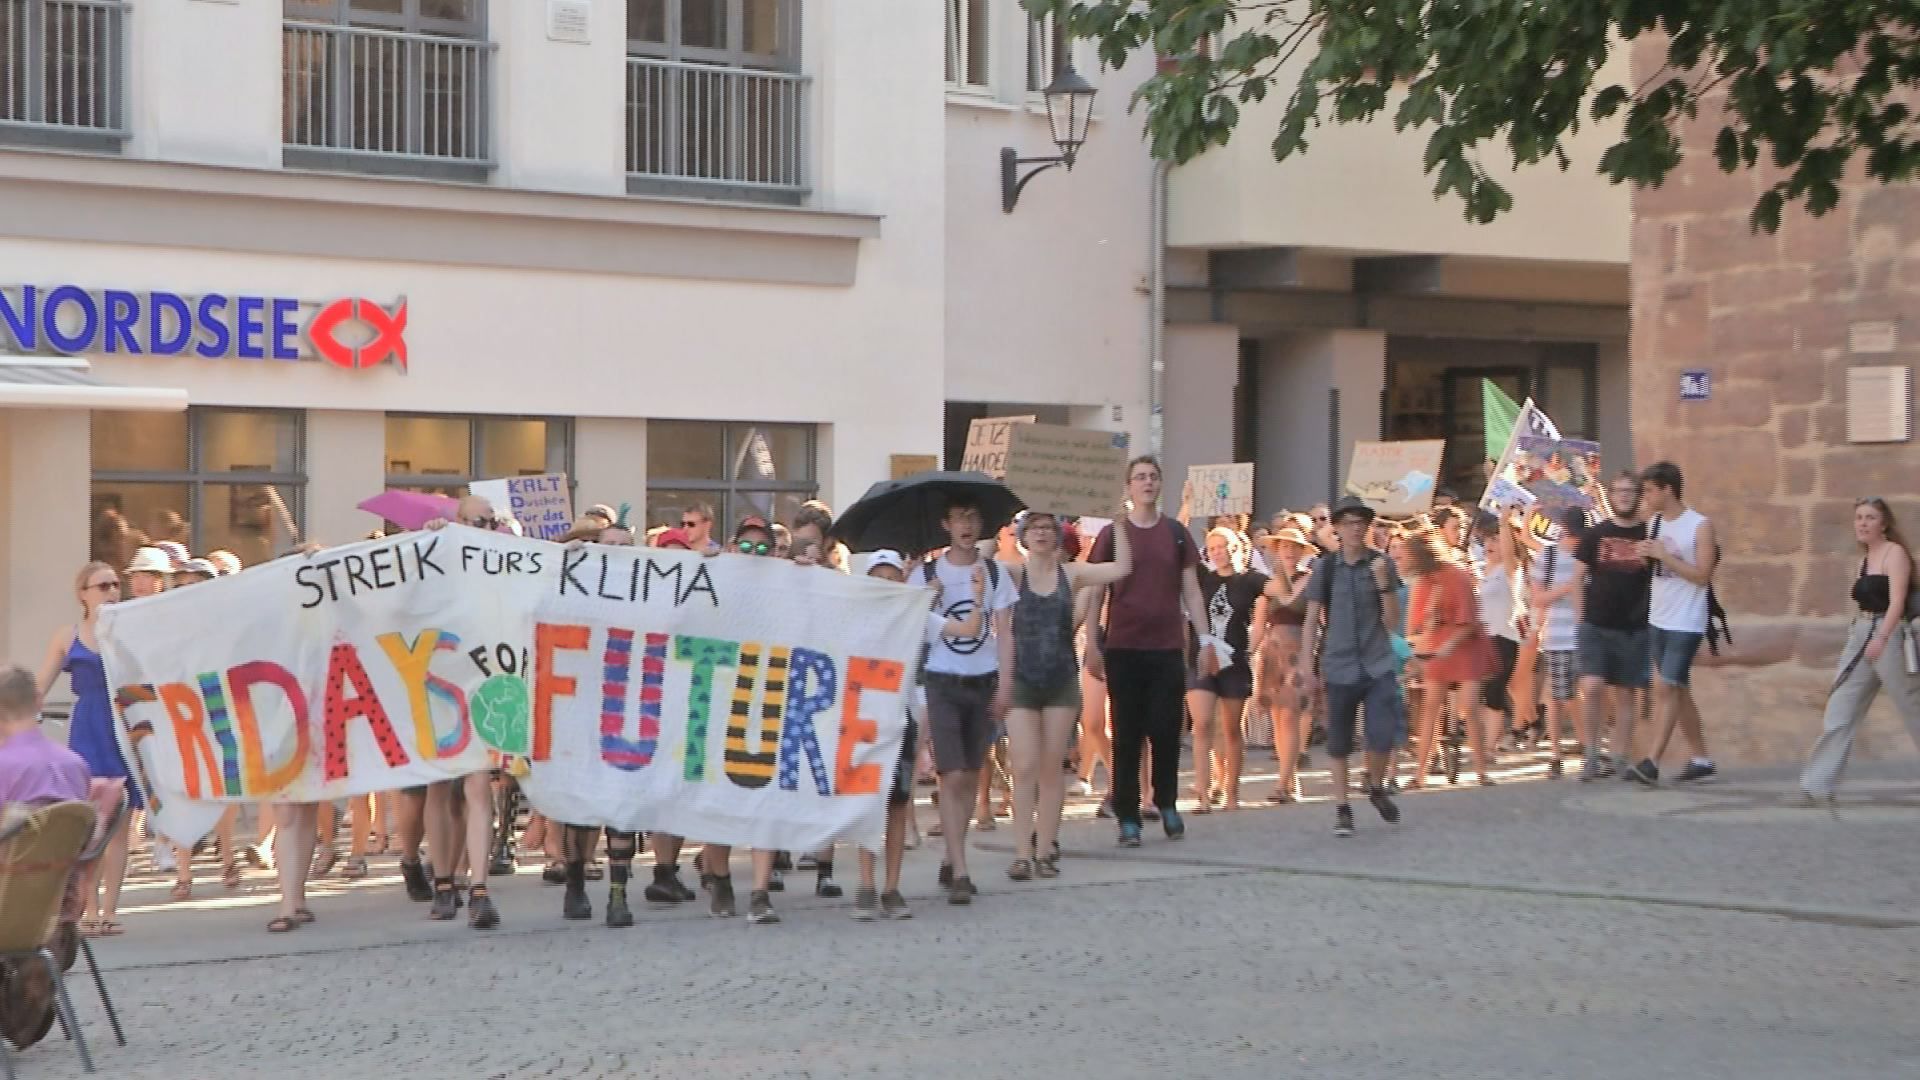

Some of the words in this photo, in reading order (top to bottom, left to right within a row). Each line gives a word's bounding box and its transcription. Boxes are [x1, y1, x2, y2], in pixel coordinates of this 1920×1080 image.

[0, 284, 299, 360] NORDSEE
[970, 421, 1009, 447] JETZ
[508, 476, 560, 493] KALT
[964, 451, 1008, 471] HANDEL
[296, 536, 445, 608] STREIK
[462, 545, 543, 575] FÜR'S
[559, 551, 720, 608] KLIMA
[115, 628, 470, 816] FRIDAYS
[532, 622, 905, 797] FUTURE
